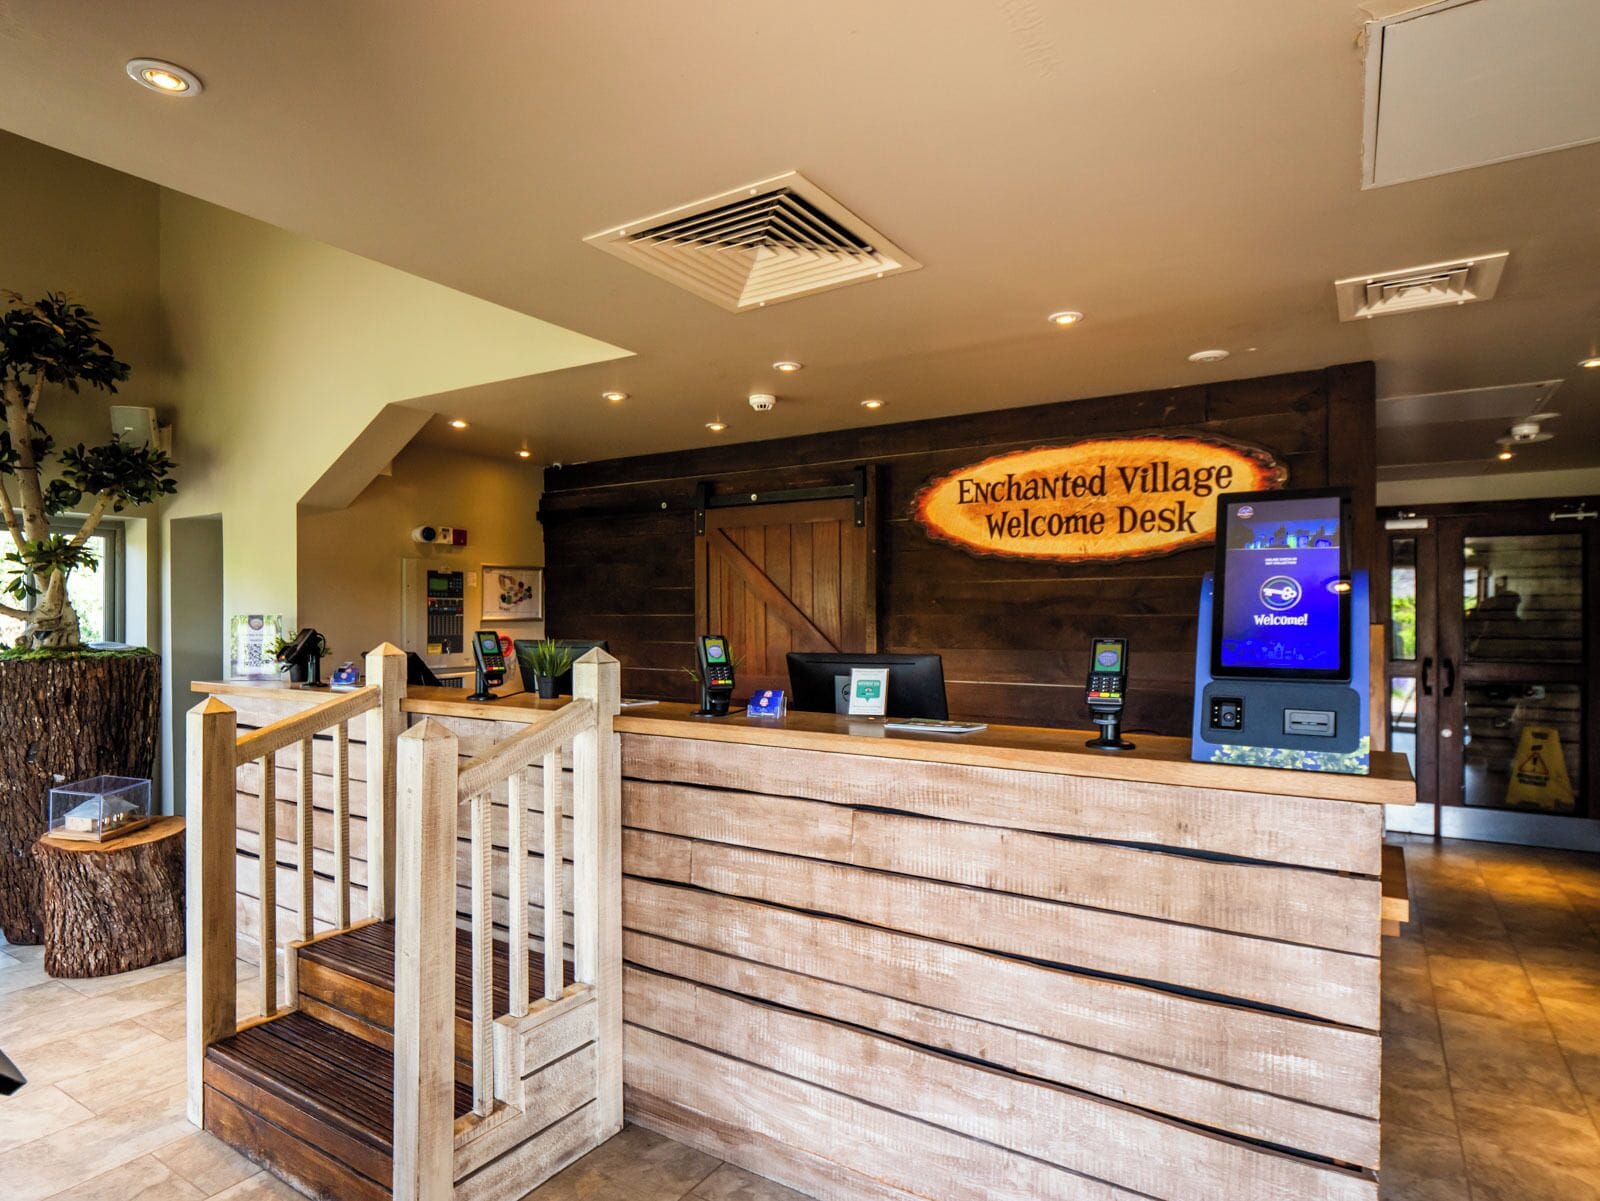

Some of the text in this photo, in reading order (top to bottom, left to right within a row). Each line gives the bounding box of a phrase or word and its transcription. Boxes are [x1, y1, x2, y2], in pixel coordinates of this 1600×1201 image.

[1117, 461, 1233, 497] Village
[986, 500, 1199, 540] Welcome Desk
[1253, 612, 1309, 626] Welcome!
